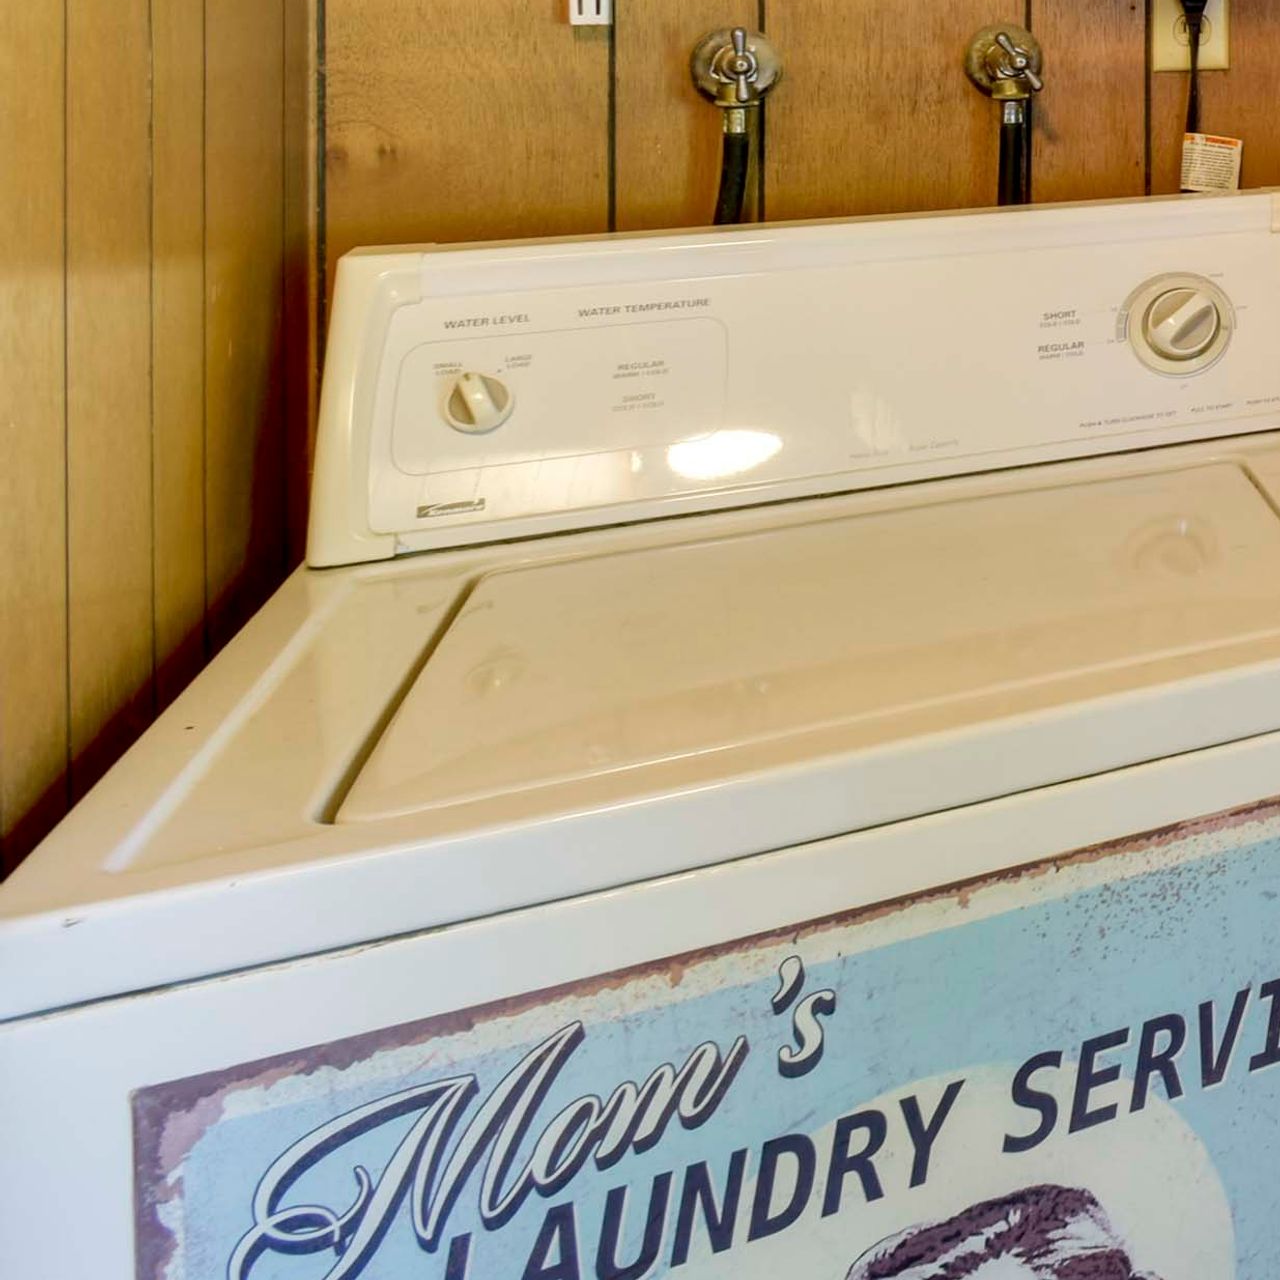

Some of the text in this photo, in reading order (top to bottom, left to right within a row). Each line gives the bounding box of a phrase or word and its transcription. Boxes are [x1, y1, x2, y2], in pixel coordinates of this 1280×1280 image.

[578, 299, 710, 318] WATER TEMPERATURE
[444, 314, 531, 330] WATER LEVEL
[1043, 310, 1076, 321] SHORT
[1037, 341, 1085, 352] REGULAR
[617, 360, 664, 371] REGULAR
[228, 956, 835, 1280] Mom's
